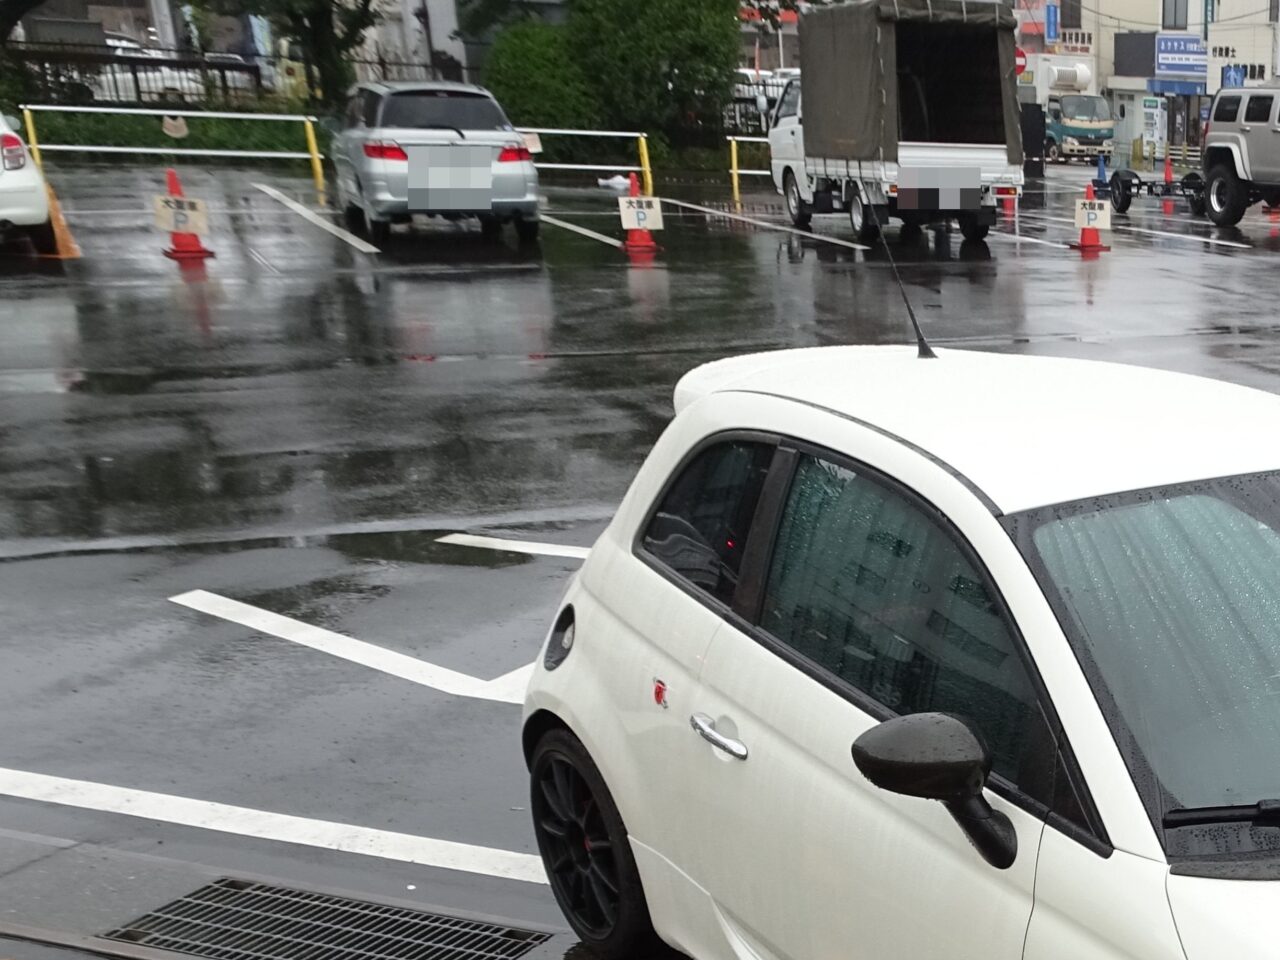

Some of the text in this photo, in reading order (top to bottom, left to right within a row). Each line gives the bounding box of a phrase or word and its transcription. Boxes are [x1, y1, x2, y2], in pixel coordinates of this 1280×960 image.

[626, 199, 654, 210] 大型車
[1080, 202, 1104, 211] 大型車
[636, 211, 647, 227] P
[1087, 212, 1097, 226] P
